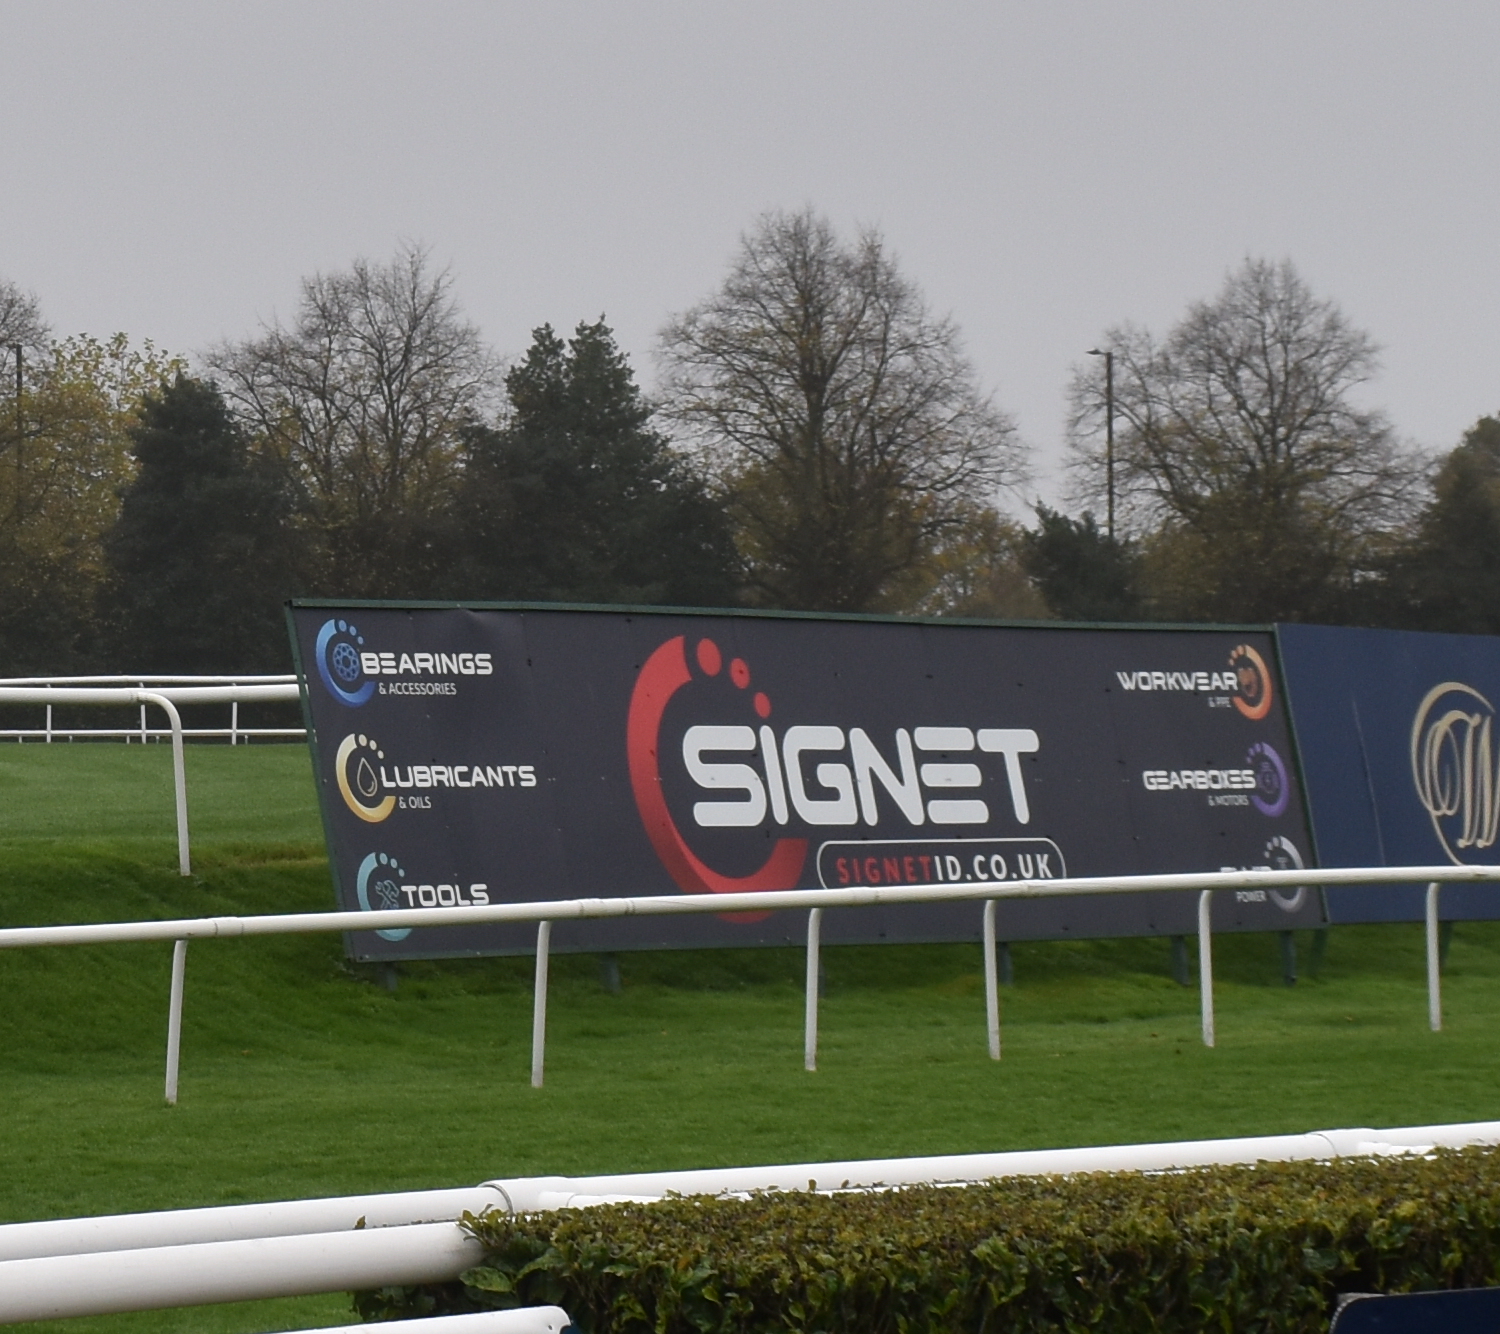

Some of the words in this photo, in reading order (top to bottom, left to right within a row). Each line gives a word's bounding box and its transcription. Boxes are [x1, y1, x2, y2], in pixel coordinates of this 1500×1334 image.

[360, 652, 493, 675] BEARINGS
[379, 682, 387, 695] &
[388, 682, 457, 695] ACCESSORIES
[1116, 671, 1239, 691] WORKWEAR
[380, 765, 537, 788] LUBRICANTS
[682, 725, 1040, 827] SIGNET
[1142, 769, 1256, 790] GEARBOXES
[399, 796, 407, 809] &
[409, 796, 432, 809] OILS
[835, 853, 1055, 884] SIGNETID.CO.UK
[401, 883, 490, 907] TOOLS
